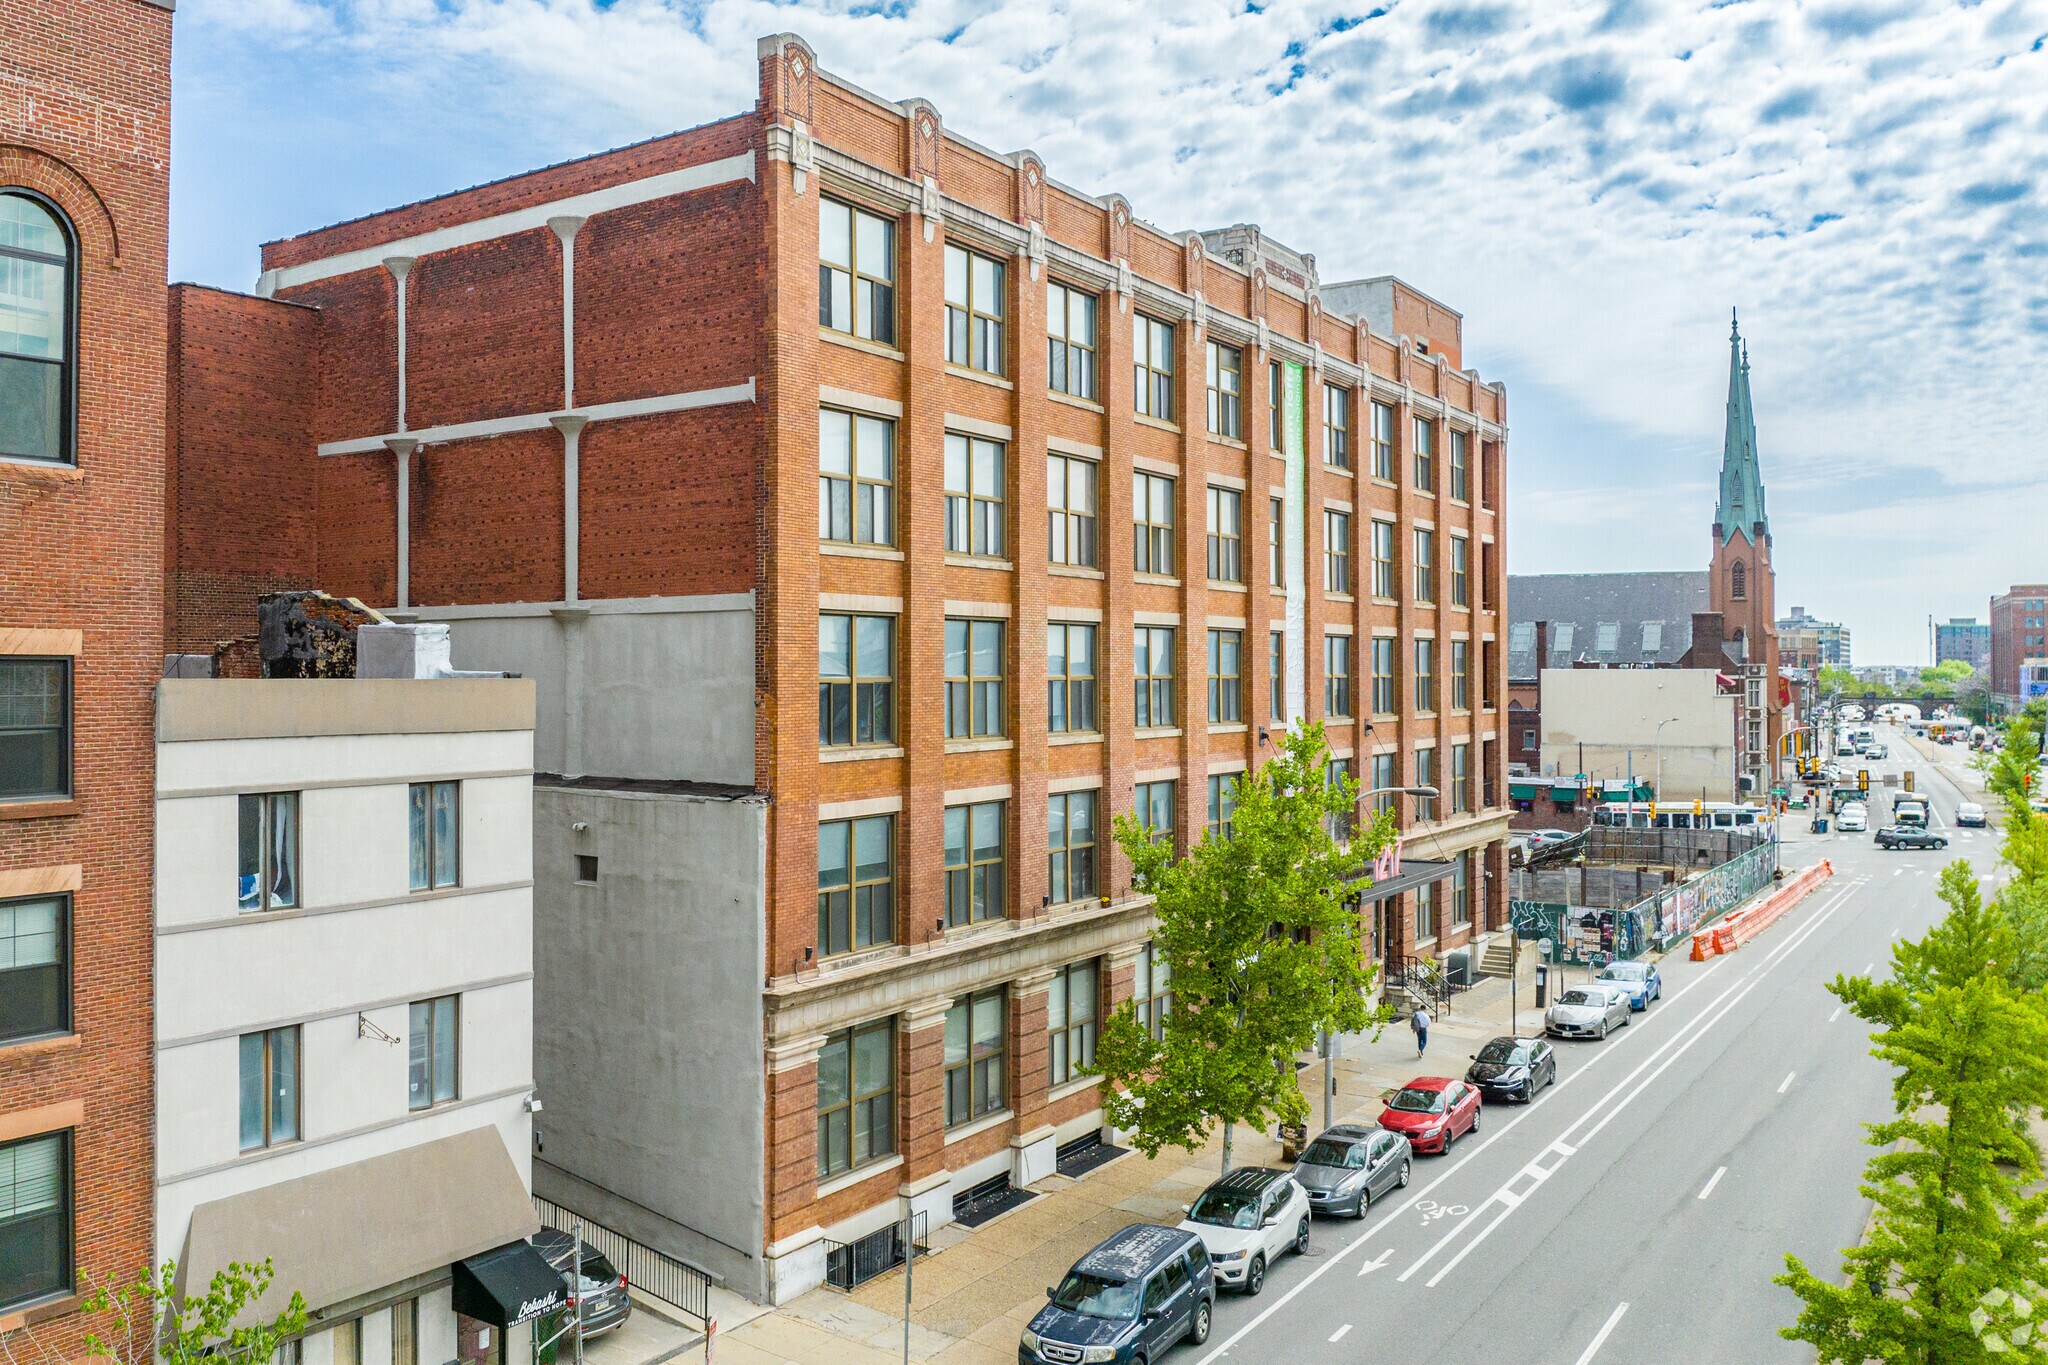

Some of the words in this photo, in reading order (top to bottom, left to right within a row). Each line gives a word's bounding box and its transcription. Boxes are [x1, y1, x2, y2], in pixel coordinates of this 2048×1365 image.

[1287, 415, 1295, 506] bedroom
[1373, 839, 1403, 881] 1217
[507, 1309, 542, 1327] TRANSITION
[543, 1306, 551, 1314] TO
[551, 1299, 567, 1310] HOPE
[517, 1290, 557, 1318] Bebashi
